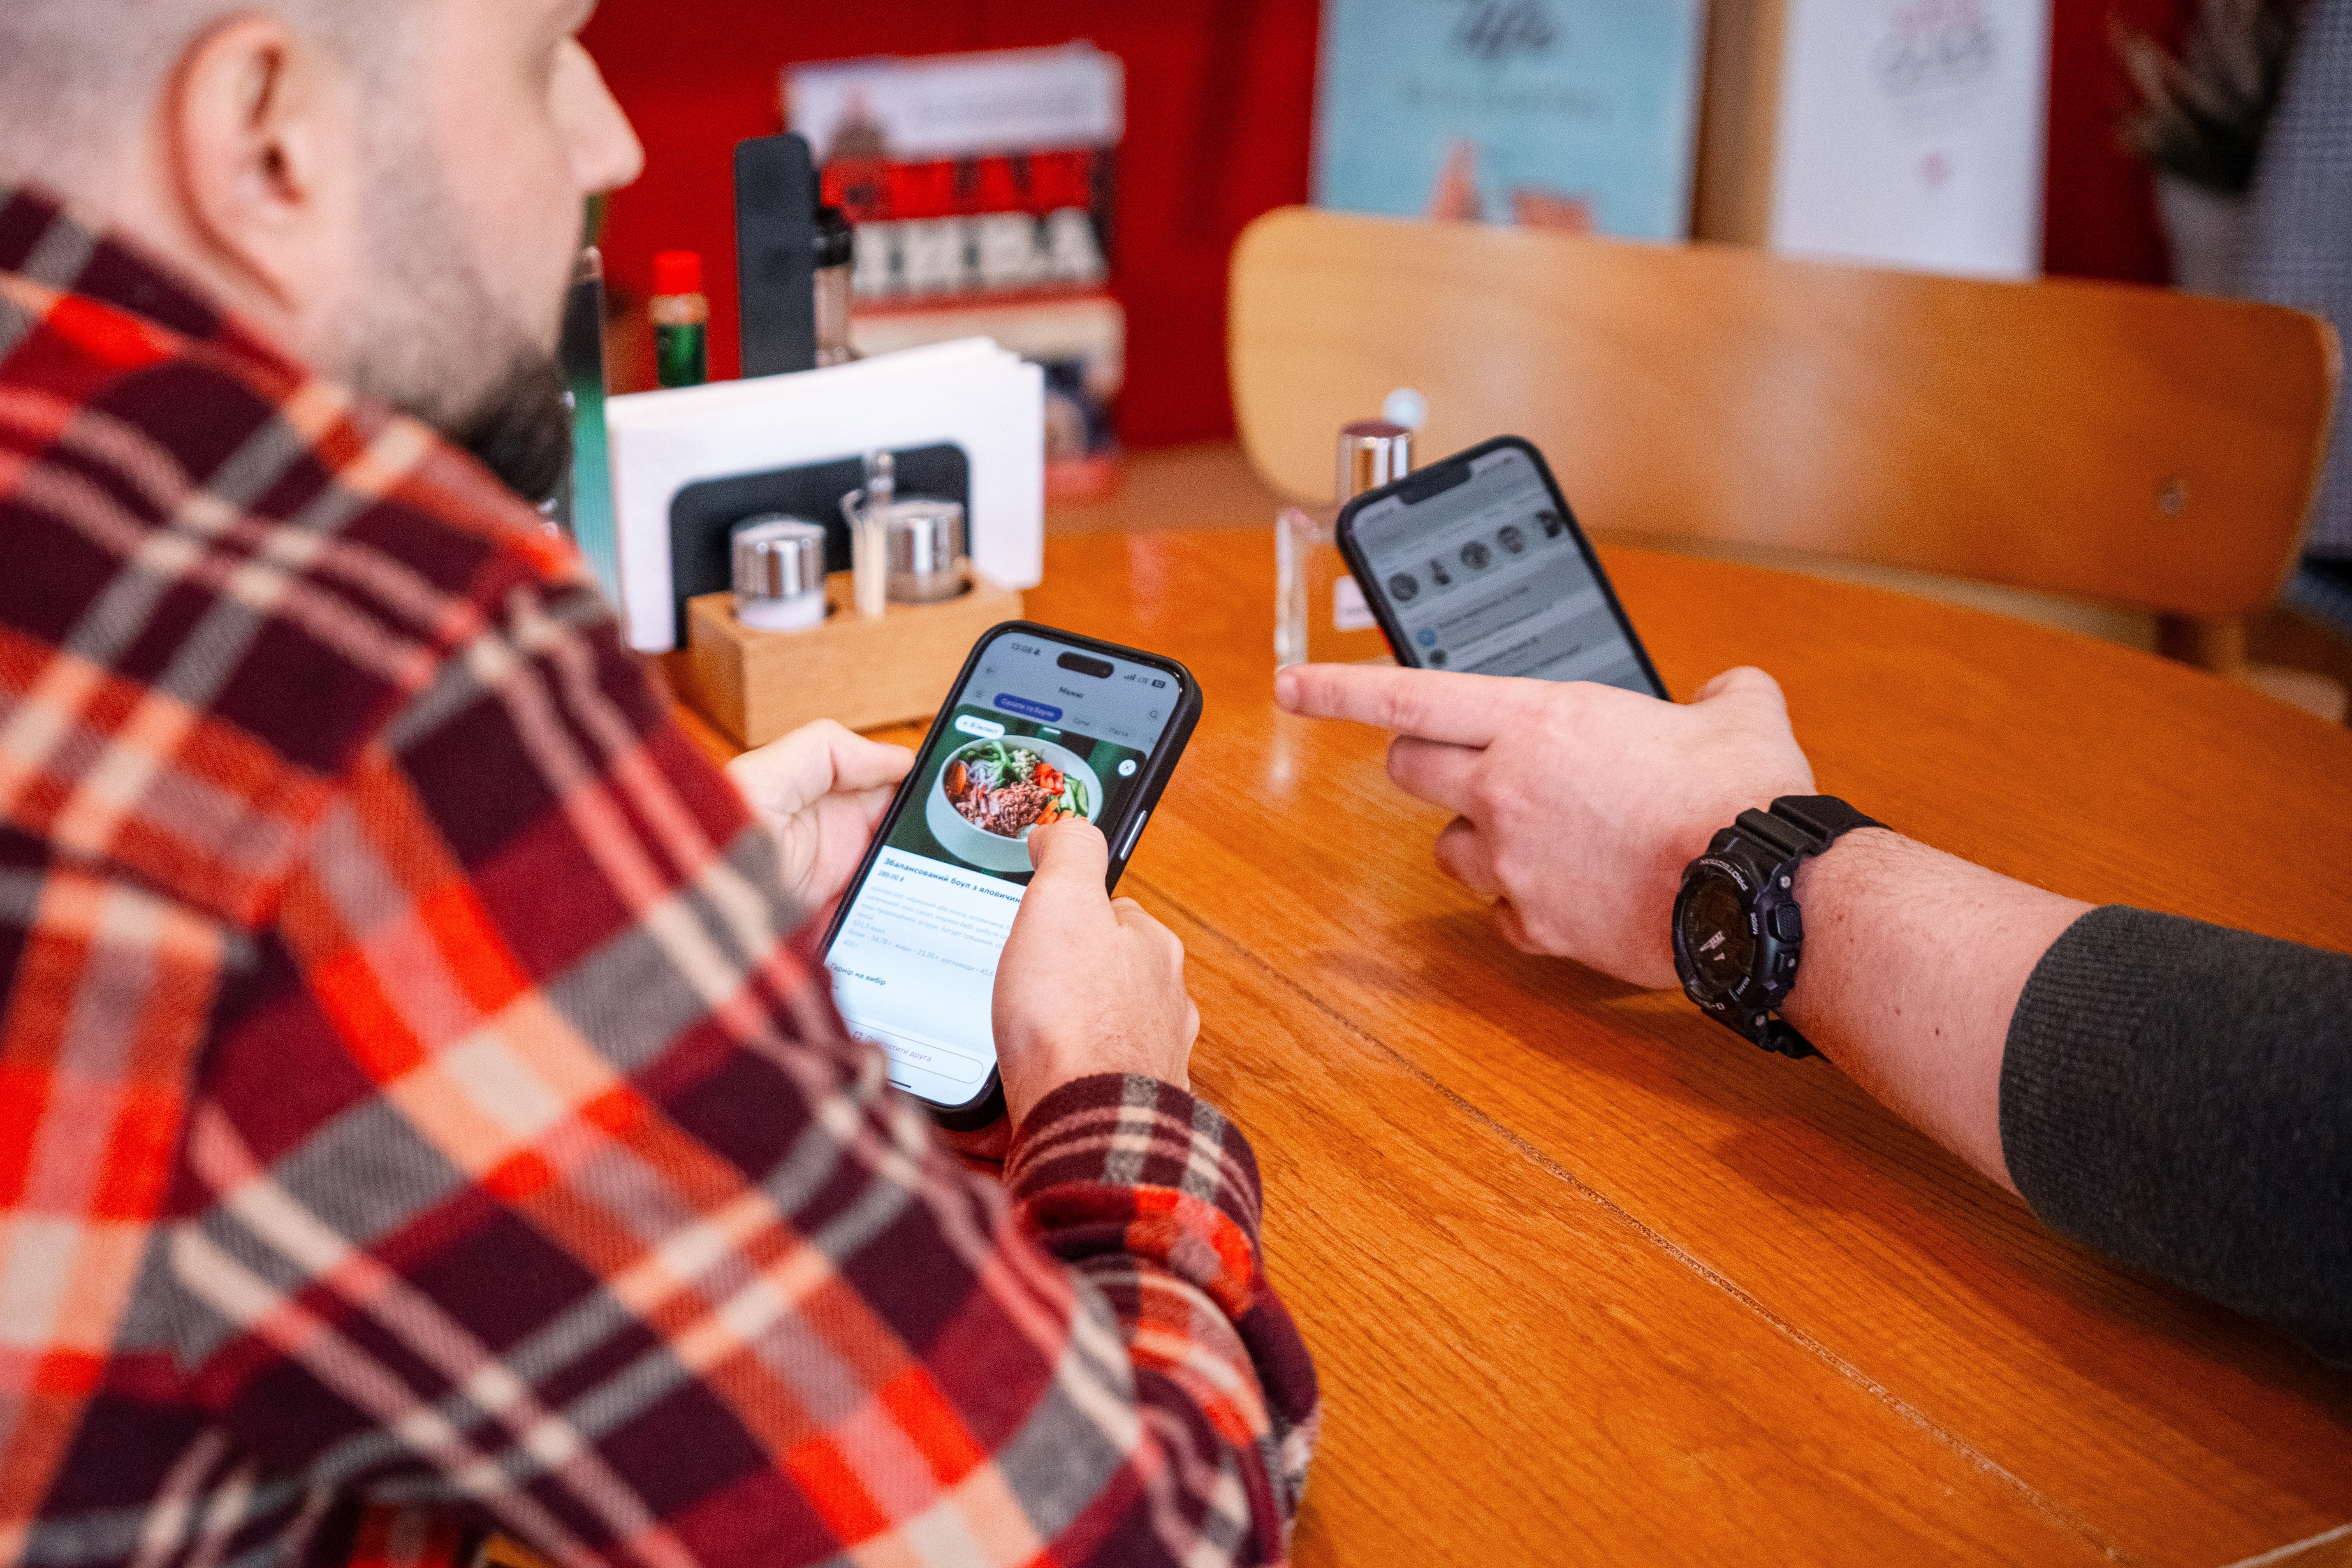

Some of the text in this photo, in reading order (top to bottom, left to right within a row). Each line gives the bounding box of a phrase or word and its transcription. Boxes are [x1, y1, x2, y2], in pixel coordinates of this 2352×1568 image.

[1059, 686, 1084, 698] Меню
[883, 857, 949, 881] Збалансований
[950, 877, 970, 889] боул
[936, 915, 957, 925] морква
[976, 926, 999, 937] цибуля
[941, 926, 962, 936] йогурт
[941, 958, 973, 970] вуглеводи
[830, 963, 853, 976] Гарнір
[865, 974, 886, 986] вибір
[909, 1052, 931, 1062] друга
